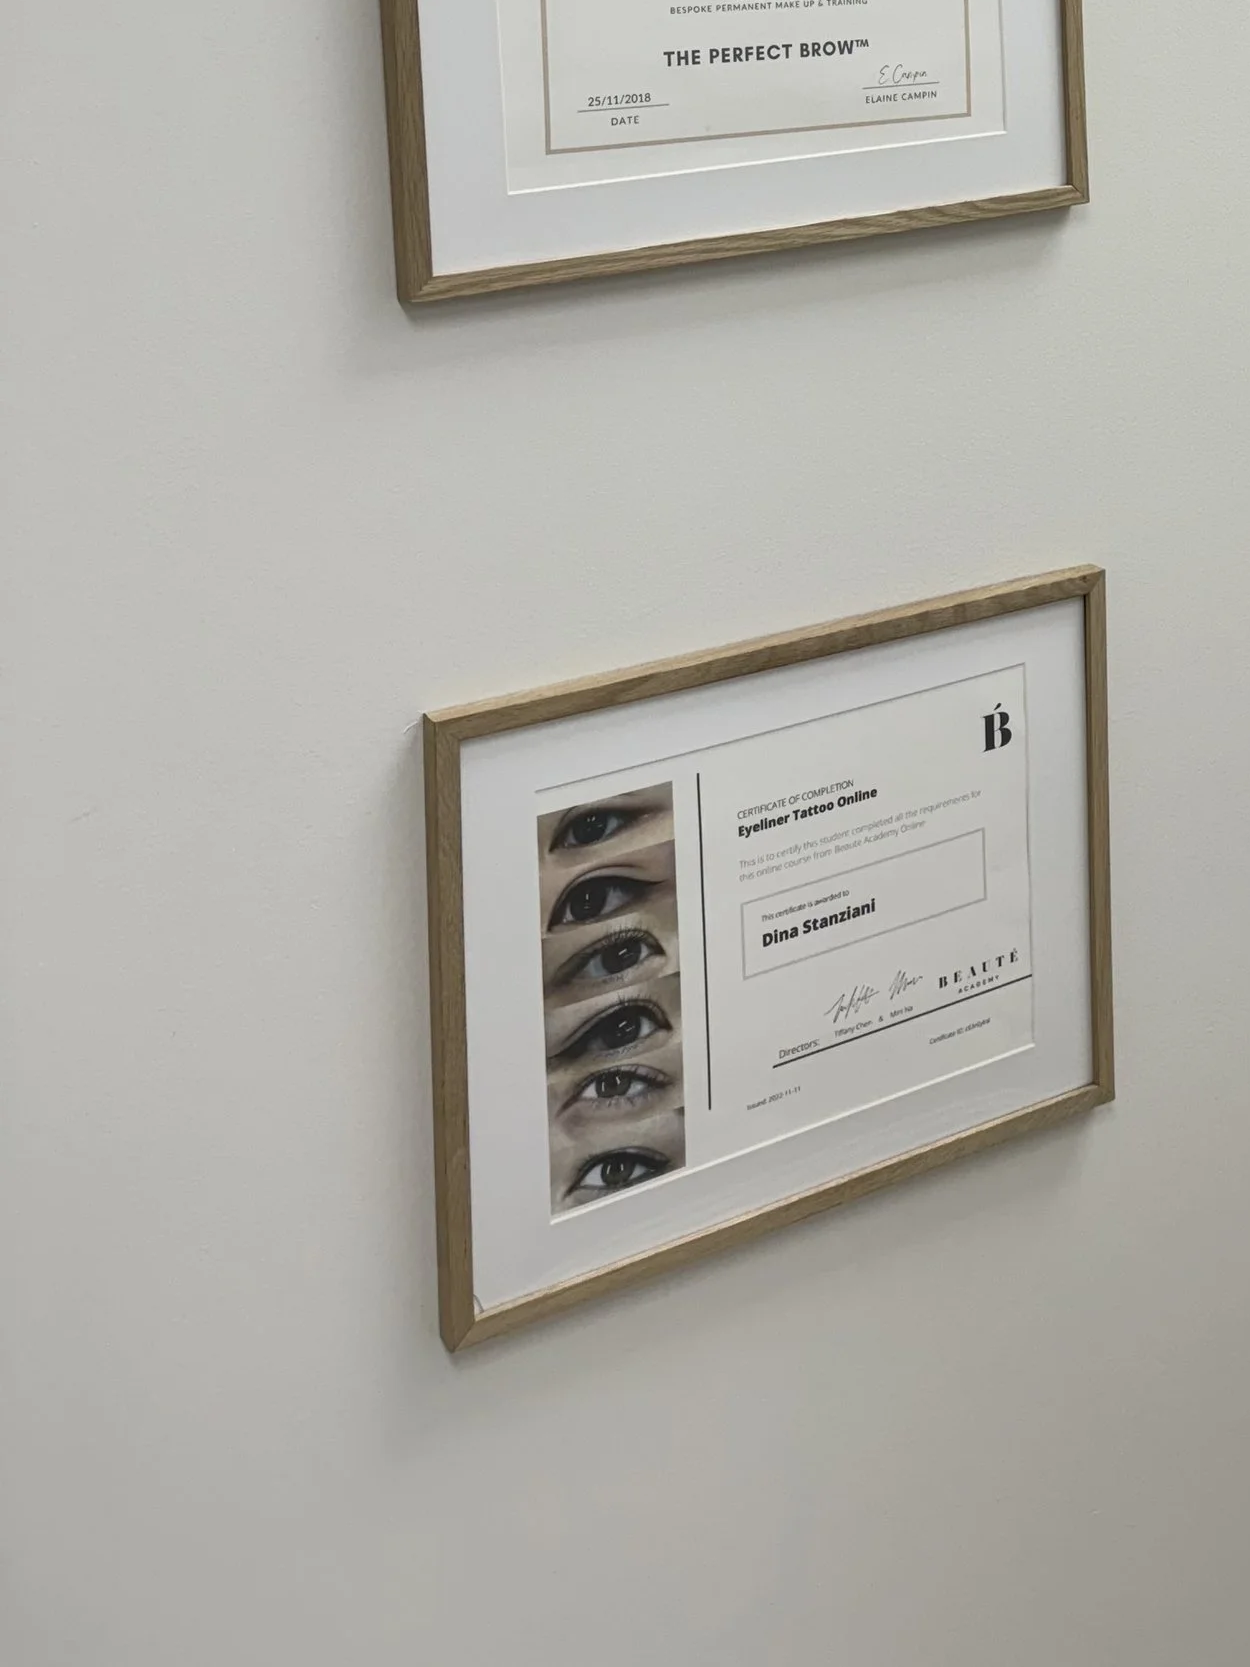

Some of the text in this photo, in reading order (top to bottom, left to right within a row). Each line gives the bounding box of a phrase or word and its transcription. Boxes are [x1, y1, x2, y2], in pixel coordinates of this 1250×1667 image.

[669, 4, 712, 15] BESPOKE
[715, 1, 772, 12] PERMANENT
[775, 0, 800, 9] MAKE
[803, 0, 815, 8] UP
[817, 0, 824, 7] &
[663, 49, 701, 67] THE
[709, 43, 793, 64] PERFECT
[587, 92, 652, 107] 25/11/2018
[865, 90, 937, 104] ELAINE CAMPIN
[610, 115, 640, 127] DATE
[736, 779, 854, 820] CERTIFICATE OF COMPLETION
[738, 788, 878, 839] Eyeliner Tattoo Online
[739, 790, 982, 870] This is to certify this student completed all the requirements for
[739, 871, 755, 883] this
[755, 863, 783, 878] online
[783, 852, 812, 870] course
[812, 848, 833, 861] from
[863, 828, 899, 844] Academy
[900, 820, 926, 834] Online
[761, 913, 775, 922] This
[774, 903, 807, 919] certificate
[813, 891, 842, 907] awarded
[842, 889, 850, 897] to
[762, 897, 876, 948] Dina Stanziani
[957, 974, 1000, 994] ACADEMY
[778, 1038, 820, 1060] Directors:
